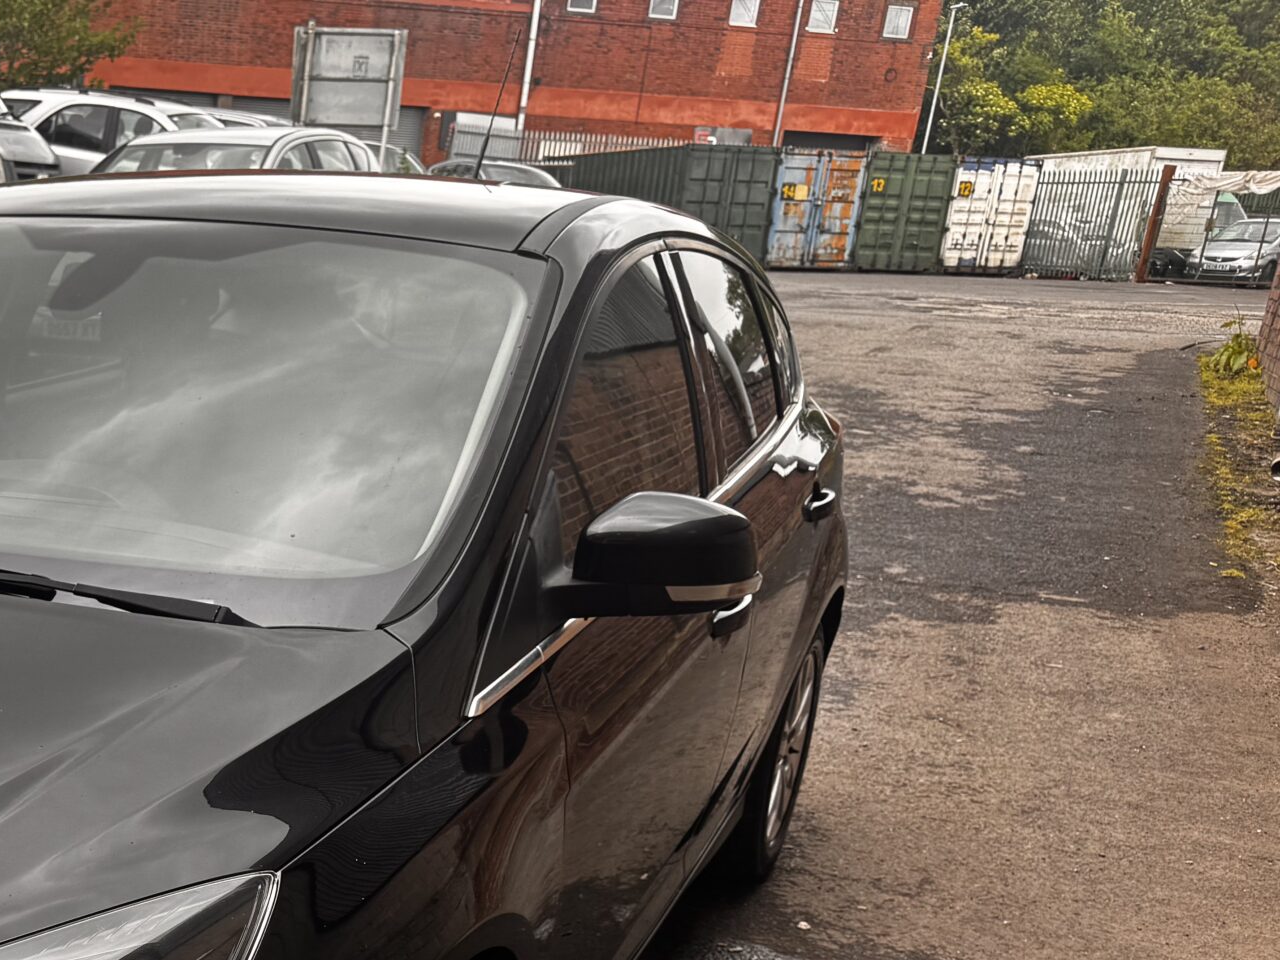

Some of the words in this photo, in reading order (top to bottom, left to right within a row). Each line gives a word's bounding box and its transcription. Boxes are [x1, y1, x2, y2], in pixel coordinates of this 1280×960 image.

[781, 184, 795, 199] 14
[870, 177, 885, 193] 13
[959, 182, 972, 196] 12
